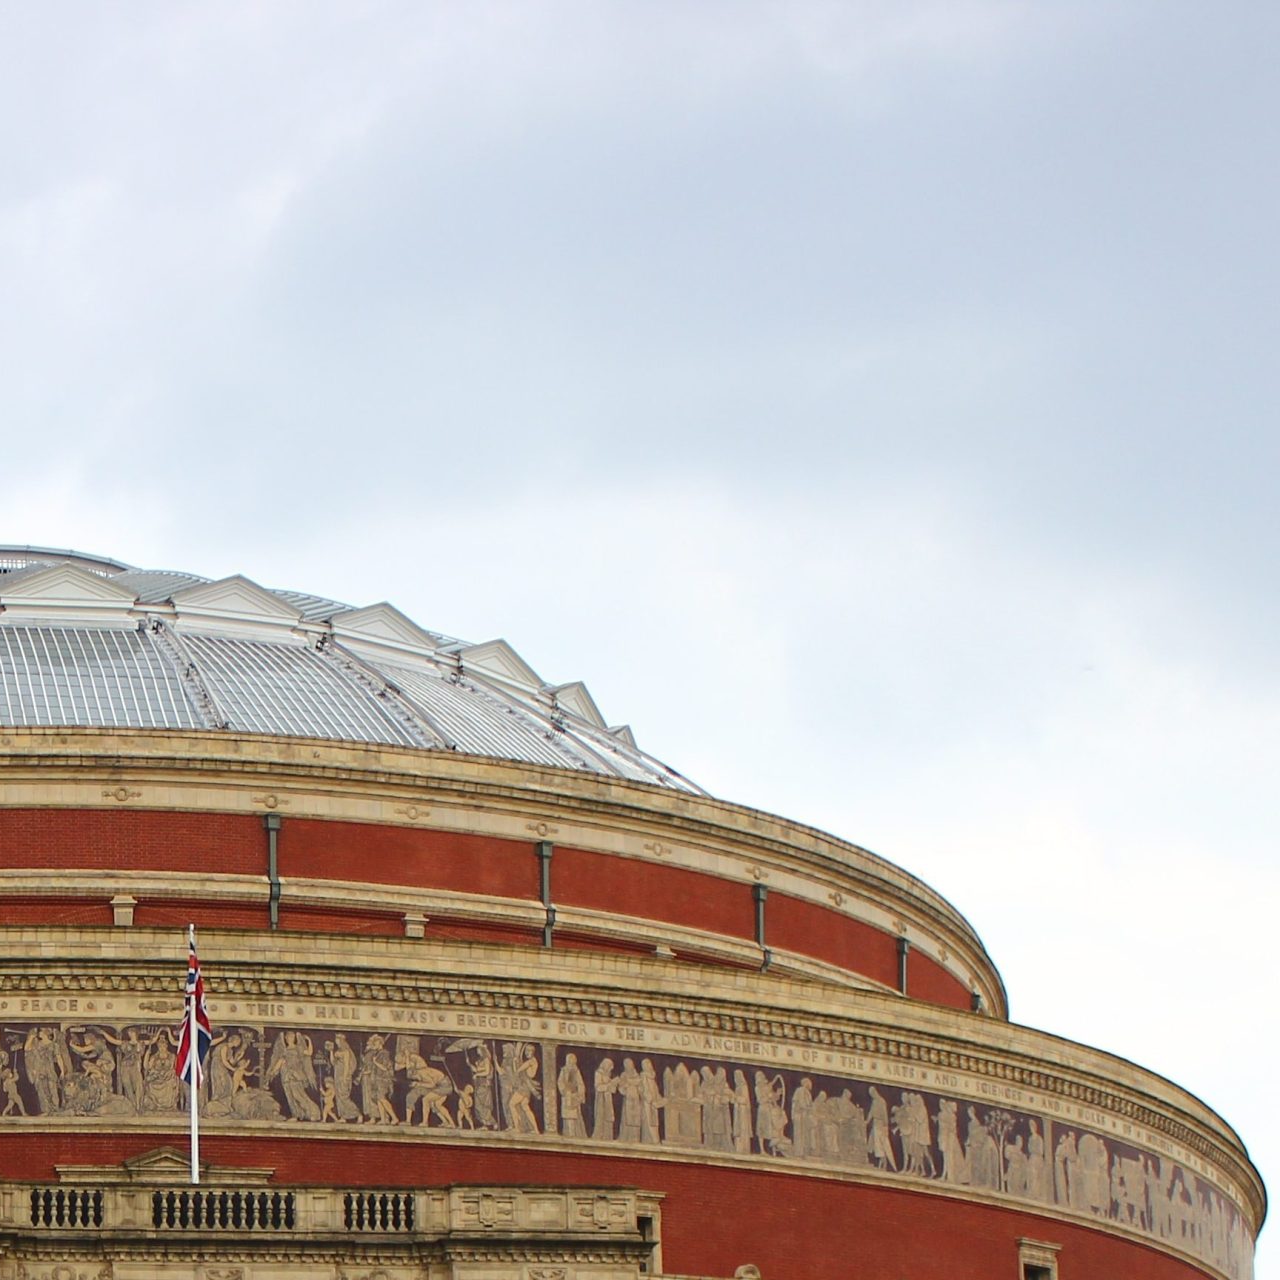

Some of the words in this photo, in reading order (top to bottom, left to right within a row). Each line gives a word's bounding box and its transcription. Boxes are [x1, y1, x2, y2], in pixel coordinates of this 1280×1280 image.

[20, 1000, 78, 1012] PEACE
[246, 1003, 285, 1017] THIS
[315, 1006, 361, 1020] HALL
[390, 1009, 429, 1024] WAS
[456, 1014, 532, 1031] ERECTED
[558, 1022, 588, 1036] FOR
[616, 1027, 645, 1042] THE
[670, 1034, 779, 1058] ADVANCEMENT
[801, 1049, 819, 1063] OF
[840, 1055, 864, 1070] THE
[885, 1063, 915, 1079] ARTS
[934, 1073, 958, 1087] AND
